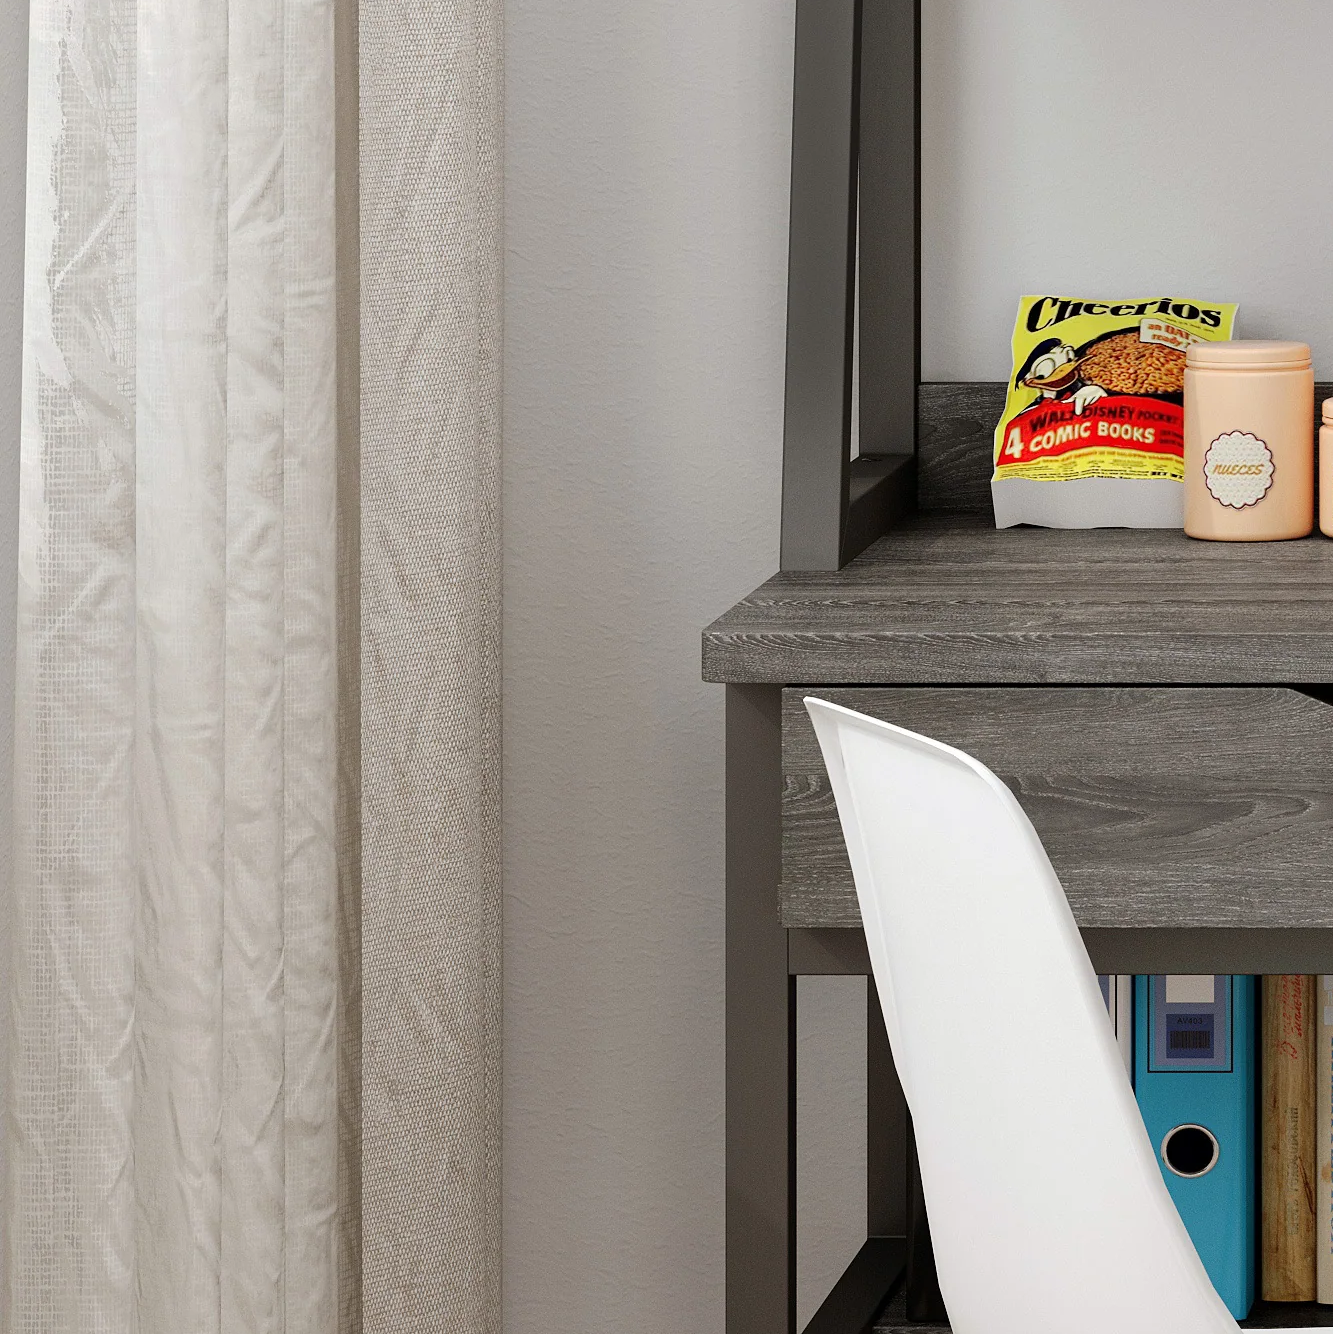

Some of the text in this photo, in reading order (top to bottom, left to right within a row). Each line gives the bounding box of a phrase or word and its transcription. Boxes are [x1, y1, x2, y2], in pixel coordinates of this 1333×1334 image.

[1025, 296, 1222, 333] Cheerios
[1082, 404, 1137, 420] DISNEY
[1004, 426, 1025, 459] 4
[1028, 421, 1092, 453] COMIC
[1097, 420, 1156, 444] BOOKS
[1176, 1017, 1203, 1025] AV403
